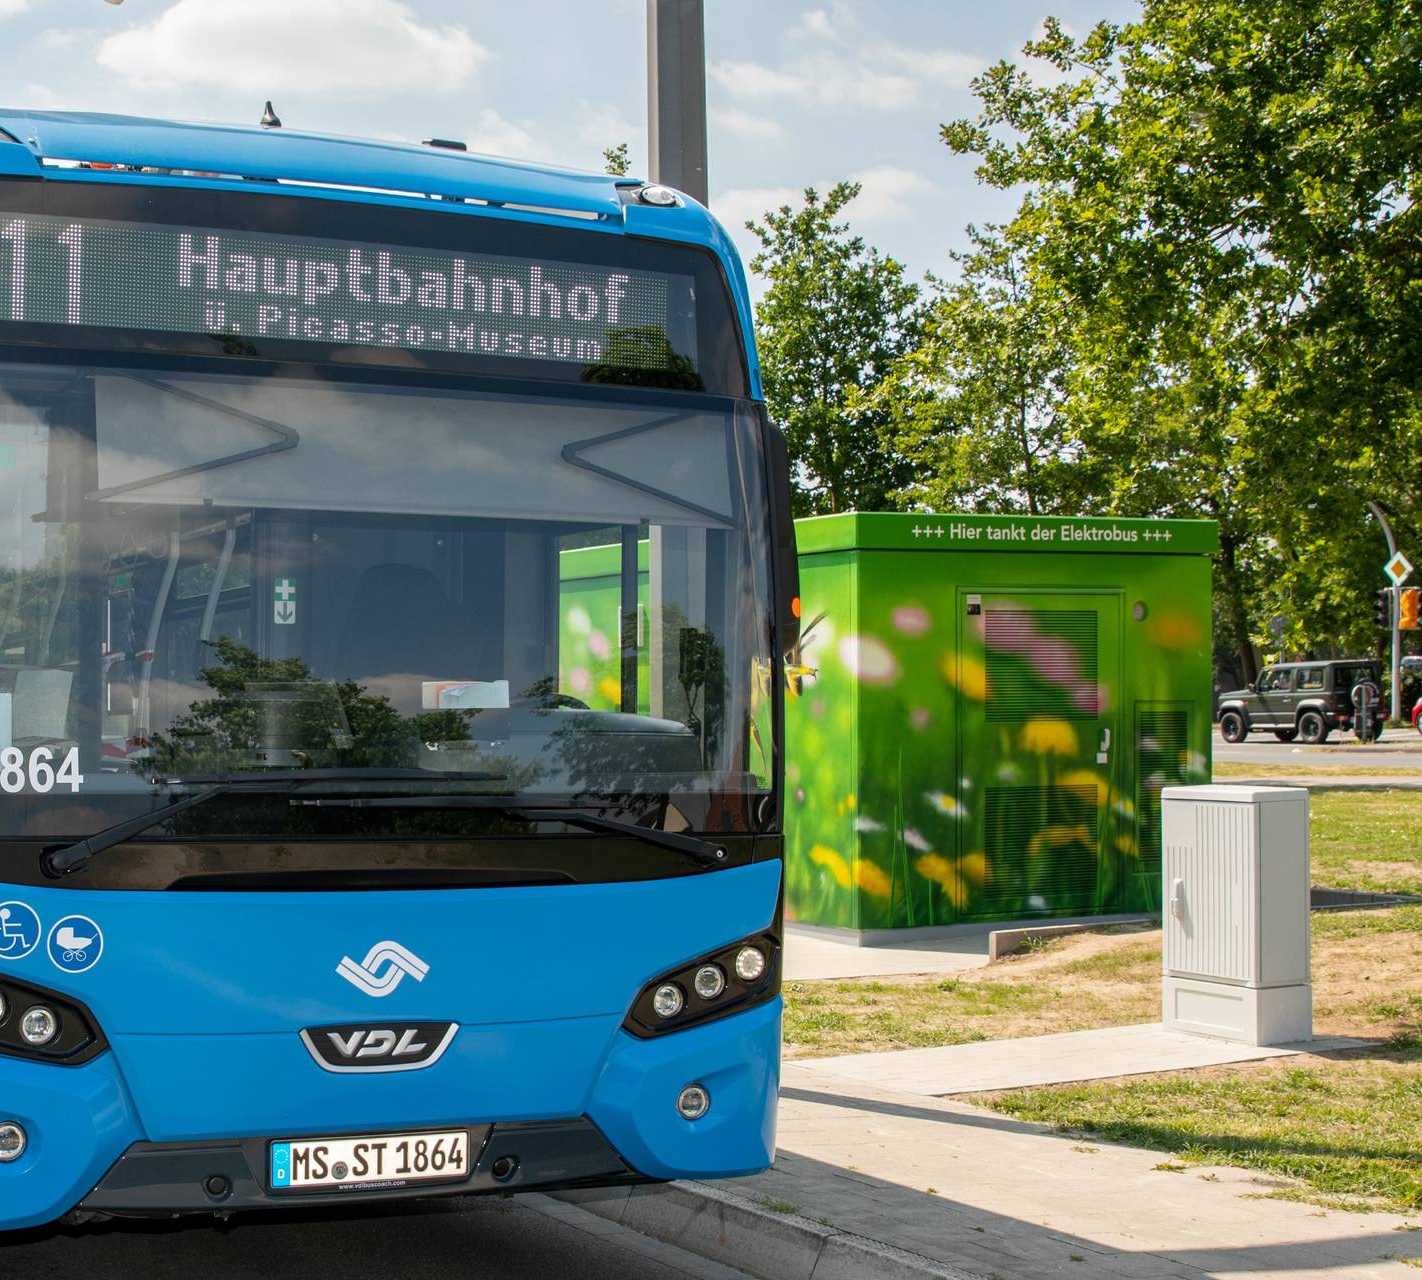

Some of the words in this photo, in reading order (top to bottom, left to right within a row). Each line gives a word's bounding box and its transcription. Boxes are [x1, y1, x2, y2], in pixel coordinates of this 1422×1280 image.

[1, 219, 82, 325] 11
[179, 233, 629, 323] Hauptbahnhof
[259, 305, 601, 359] Picasso-Museum
[949, 523, 982, 539] Hier
[987, 524, 1026, 541] tankt
[1031, 524, 1056, 541] der
[1061, 525, 1138, 542] Elektrobus
[327, 1029, 427, 1058] VDL
[277, 1168, 285, 1179] D
[292, 1146, 328, 1181] MS
[352, 1142, 388, 1177] ST
[395, 1137, 463, 1174] 1864
